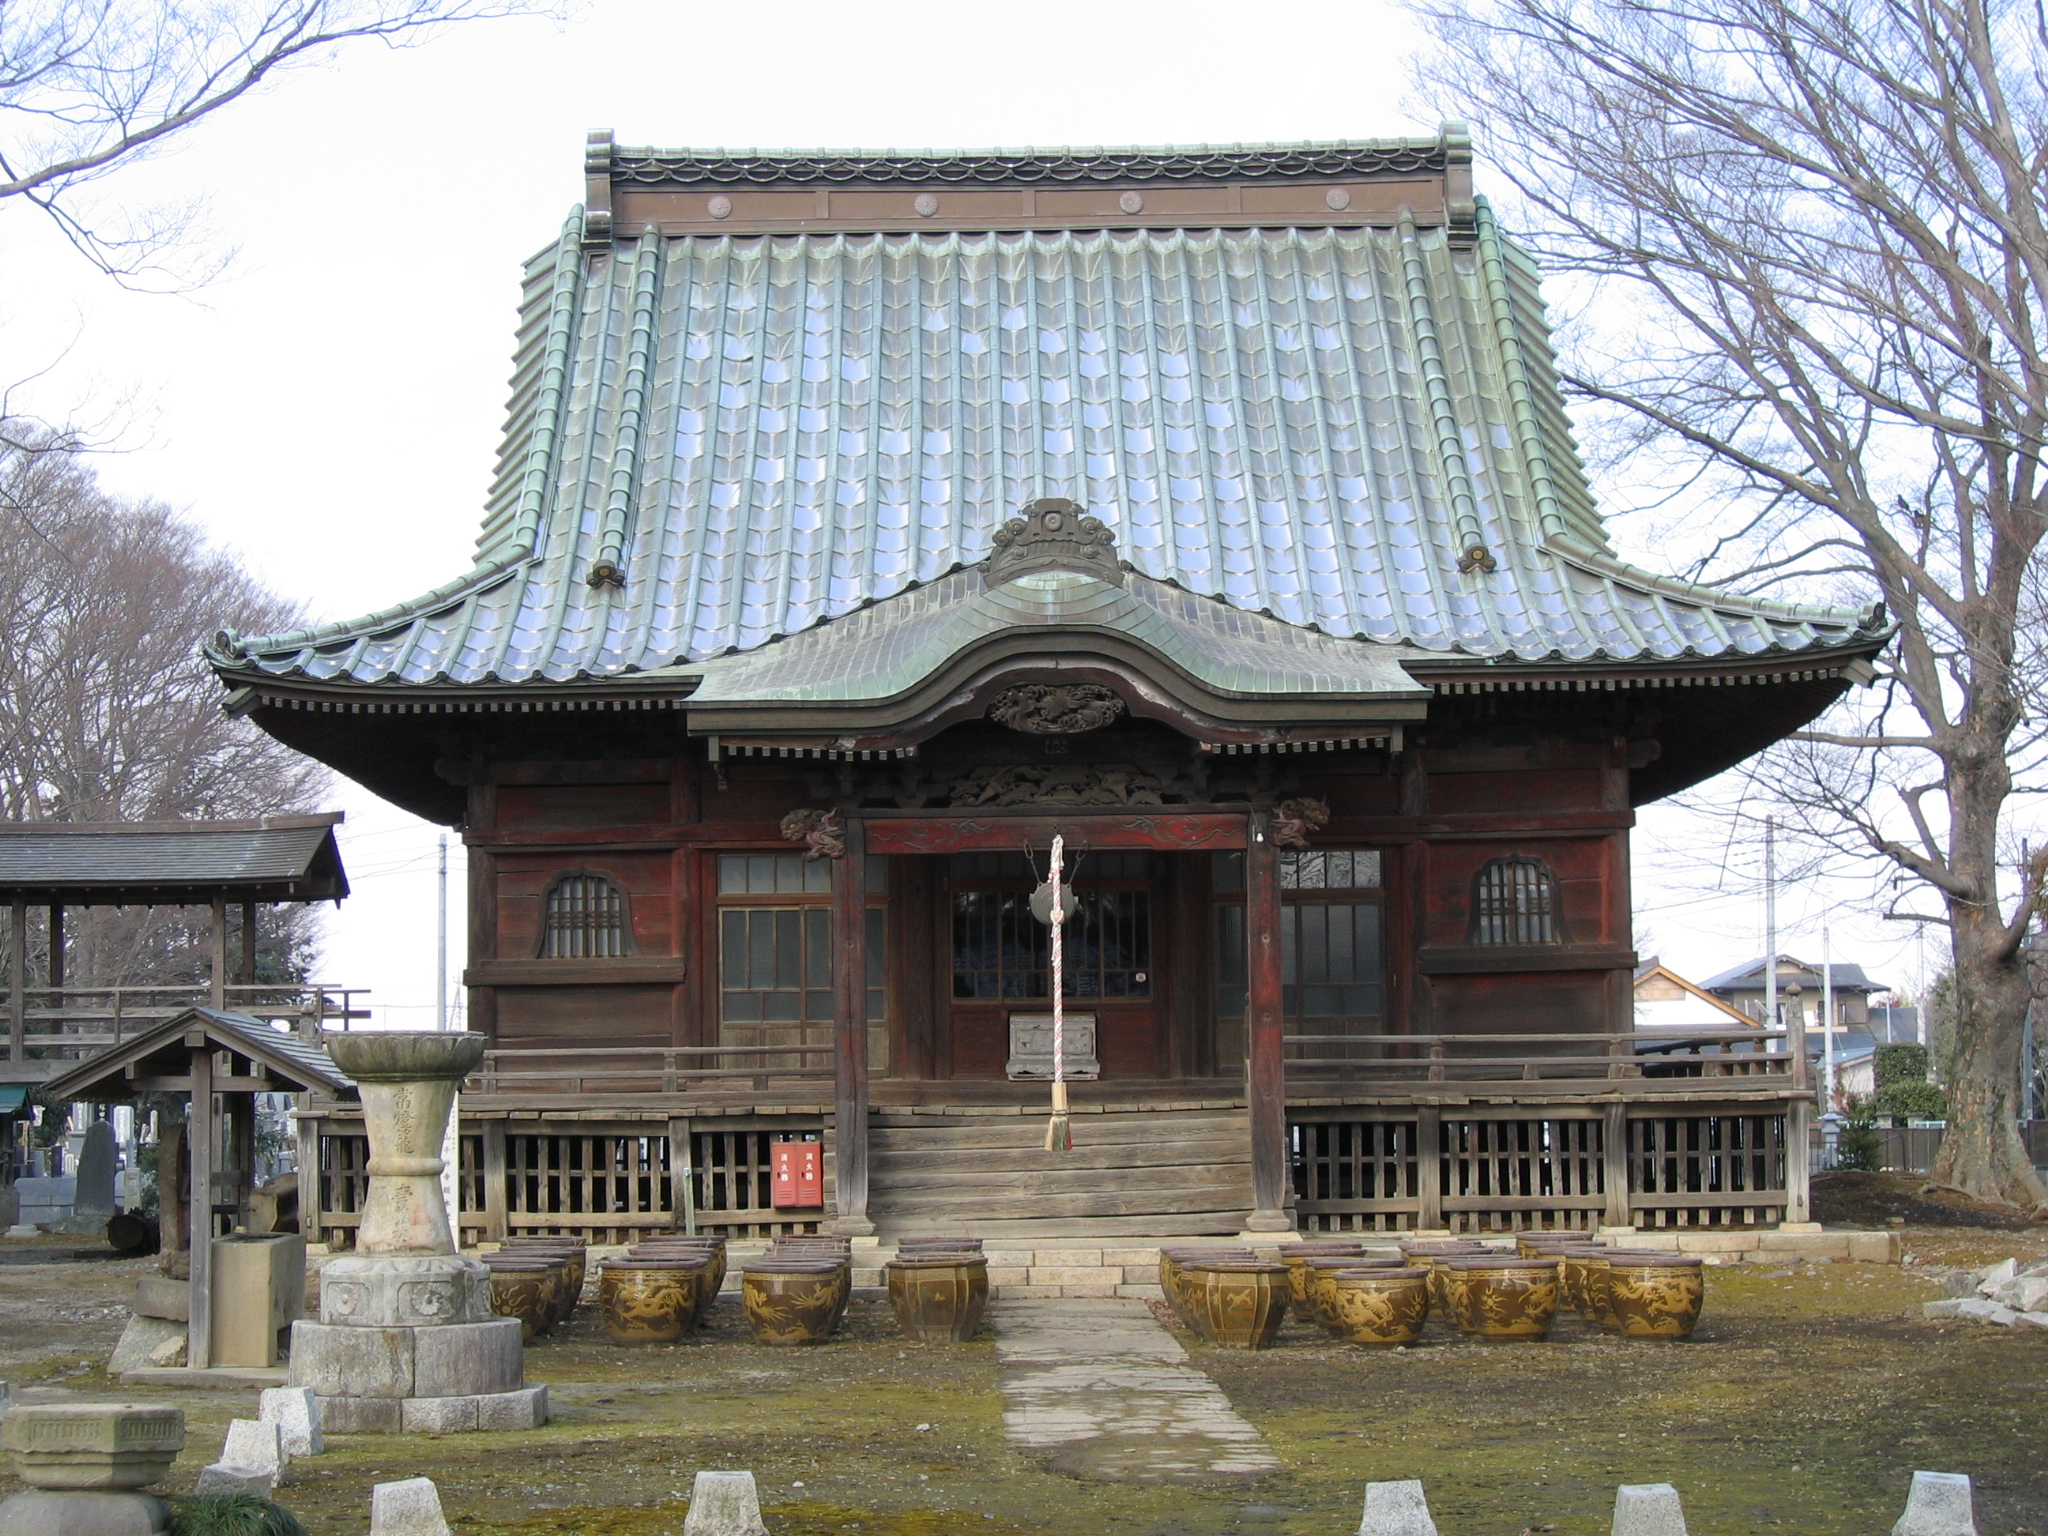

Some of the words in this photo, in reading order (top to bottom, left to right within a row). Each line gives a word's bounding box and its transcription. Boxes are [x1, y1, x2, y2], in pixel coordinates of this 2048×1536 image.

[780, 1153, 789, 1182] 消火器
[805, 1152, 814, 1181] 消火器
